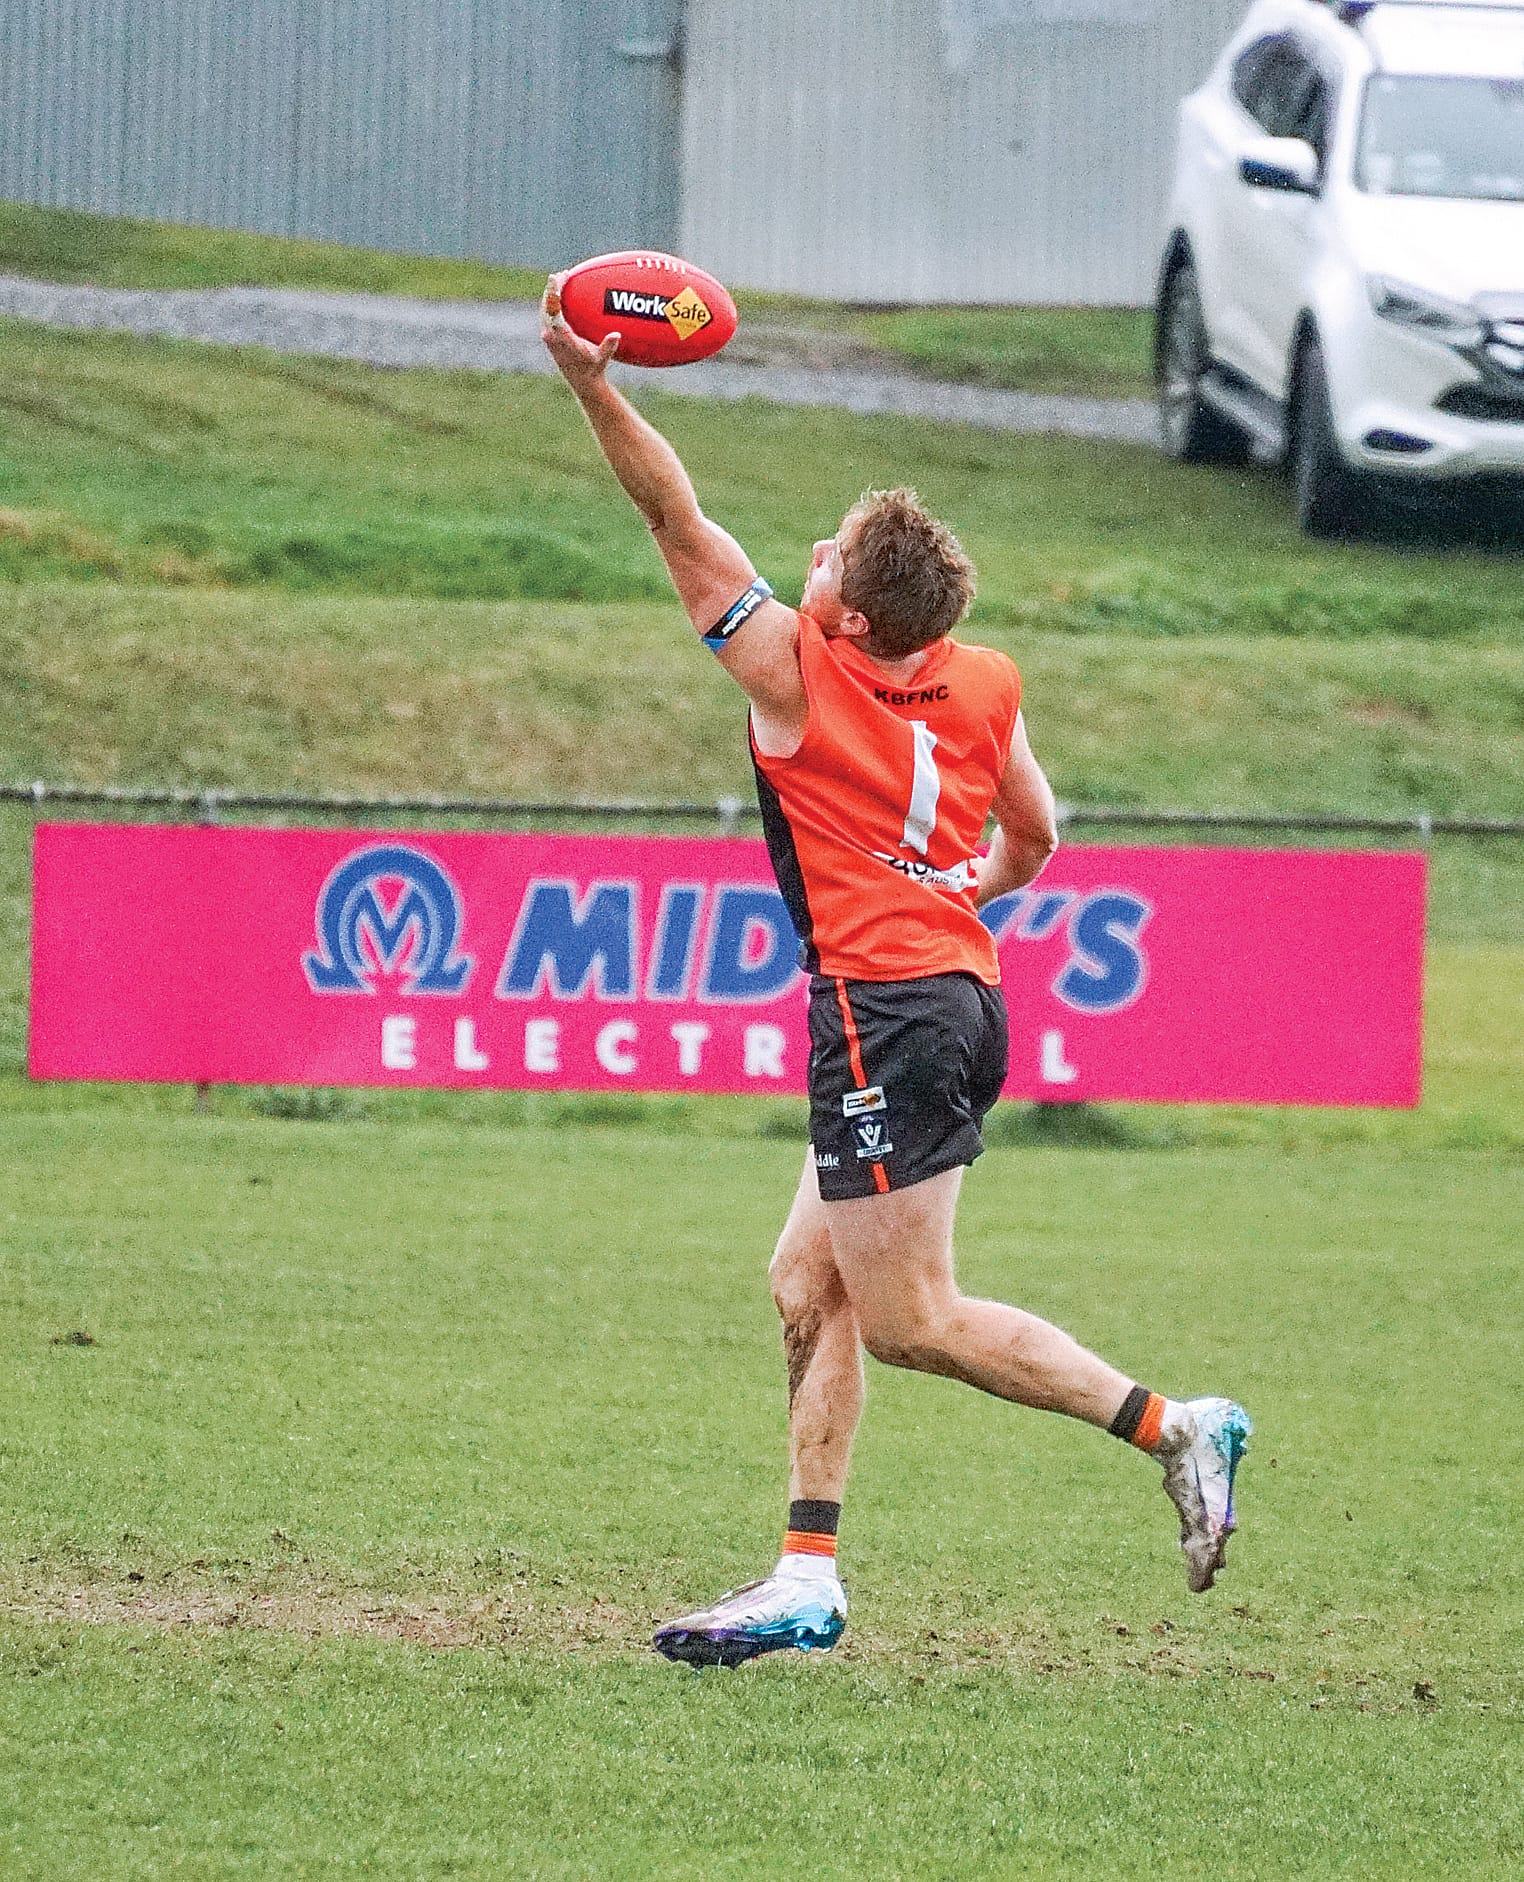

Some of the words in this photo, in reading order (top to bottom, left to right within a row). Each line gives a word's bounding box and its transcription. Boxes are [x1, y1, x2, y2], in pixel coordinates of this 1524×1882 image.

[874, 685, 949, 706] KBFNC
[899, 719, 940, 856] 1
[495, 878, 1153, 1013] MID'S
[380, 1015, 1078, 1084] ELECTRL
